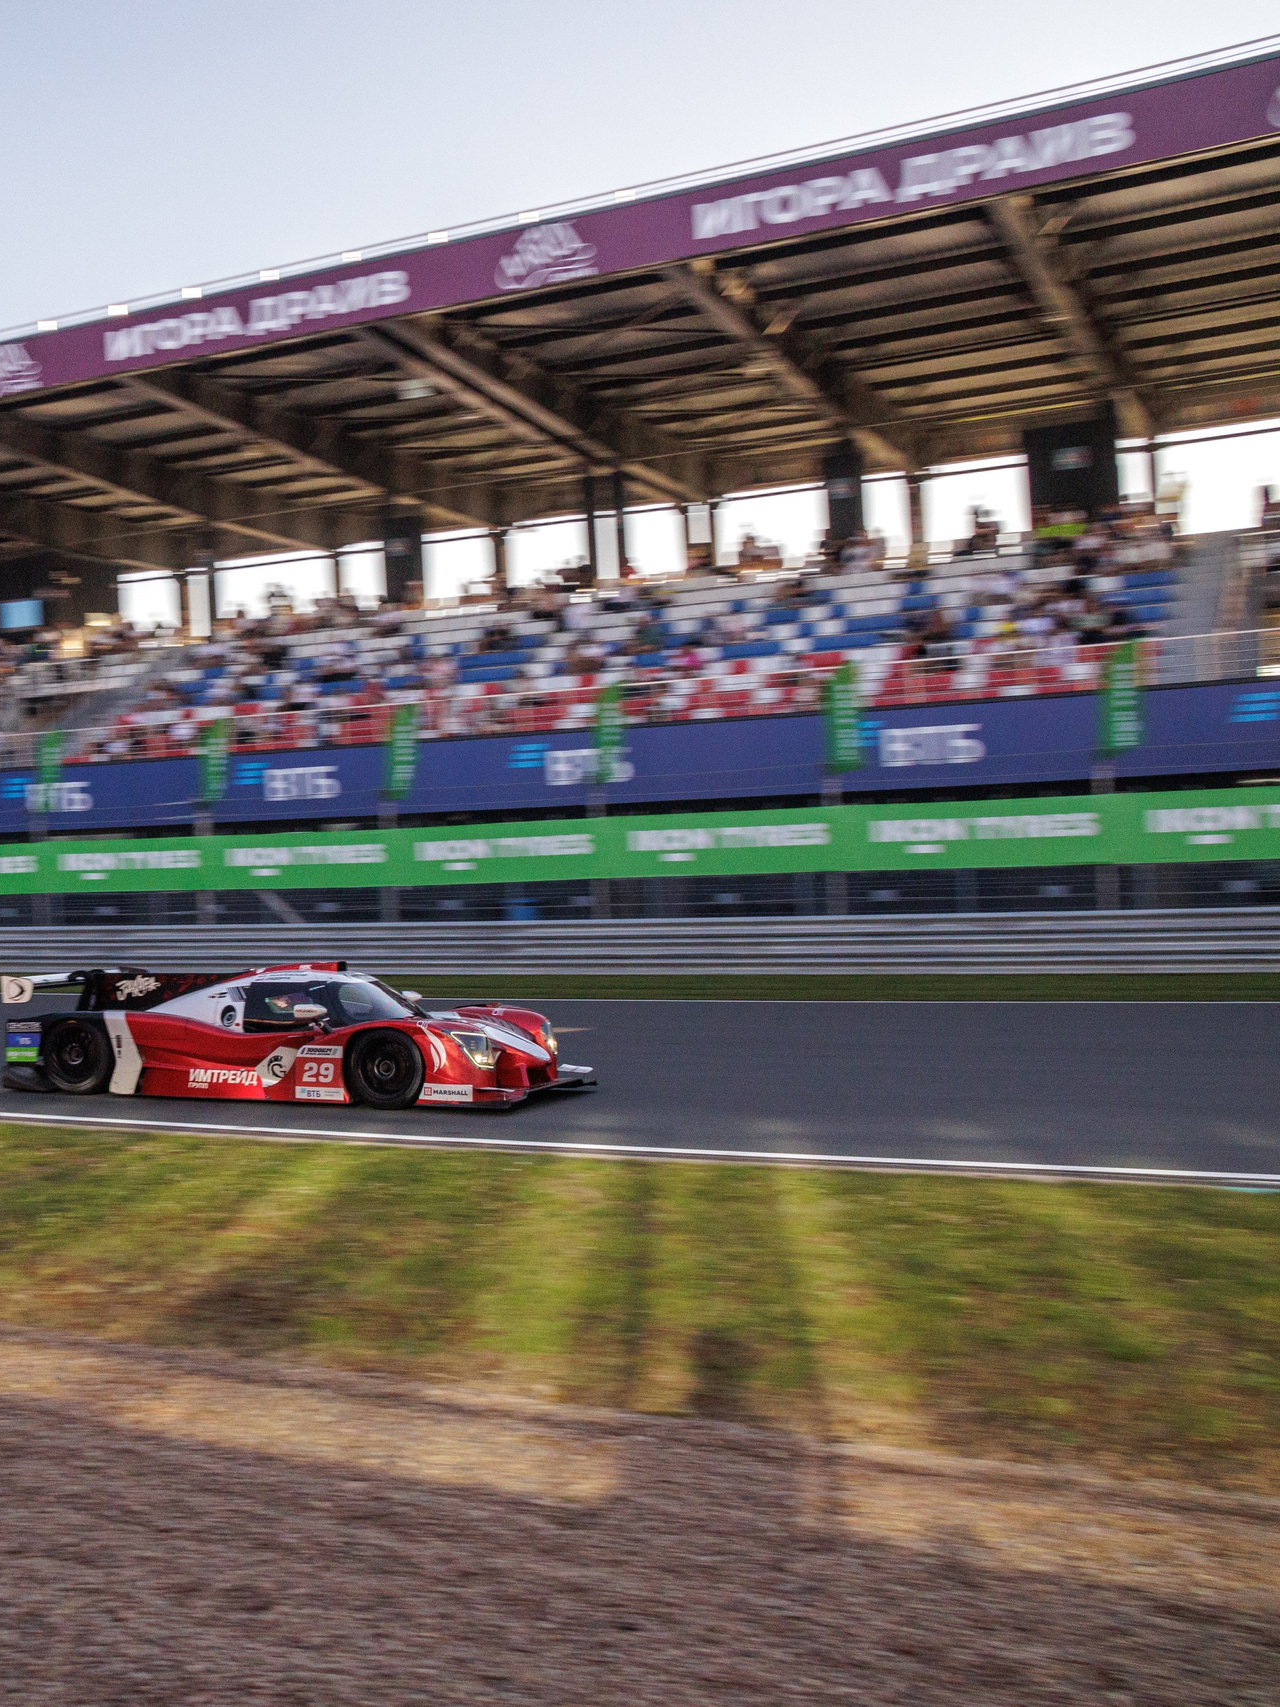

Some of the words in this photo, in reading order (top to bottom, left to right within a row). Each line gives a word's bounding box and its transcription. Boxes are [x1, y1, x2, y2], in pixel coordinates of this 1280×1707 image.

[691, 167, 894, 240] ИГОРА
[104, 307, 245, 361] ИГОРА
[878, 724, 987, 767] ВТБ
[263, 766, 341, 801] ВТБ
[189, 1069, 258, 1086] ИМТРЕЙД
[302, 1062, 335, 1083] 29
